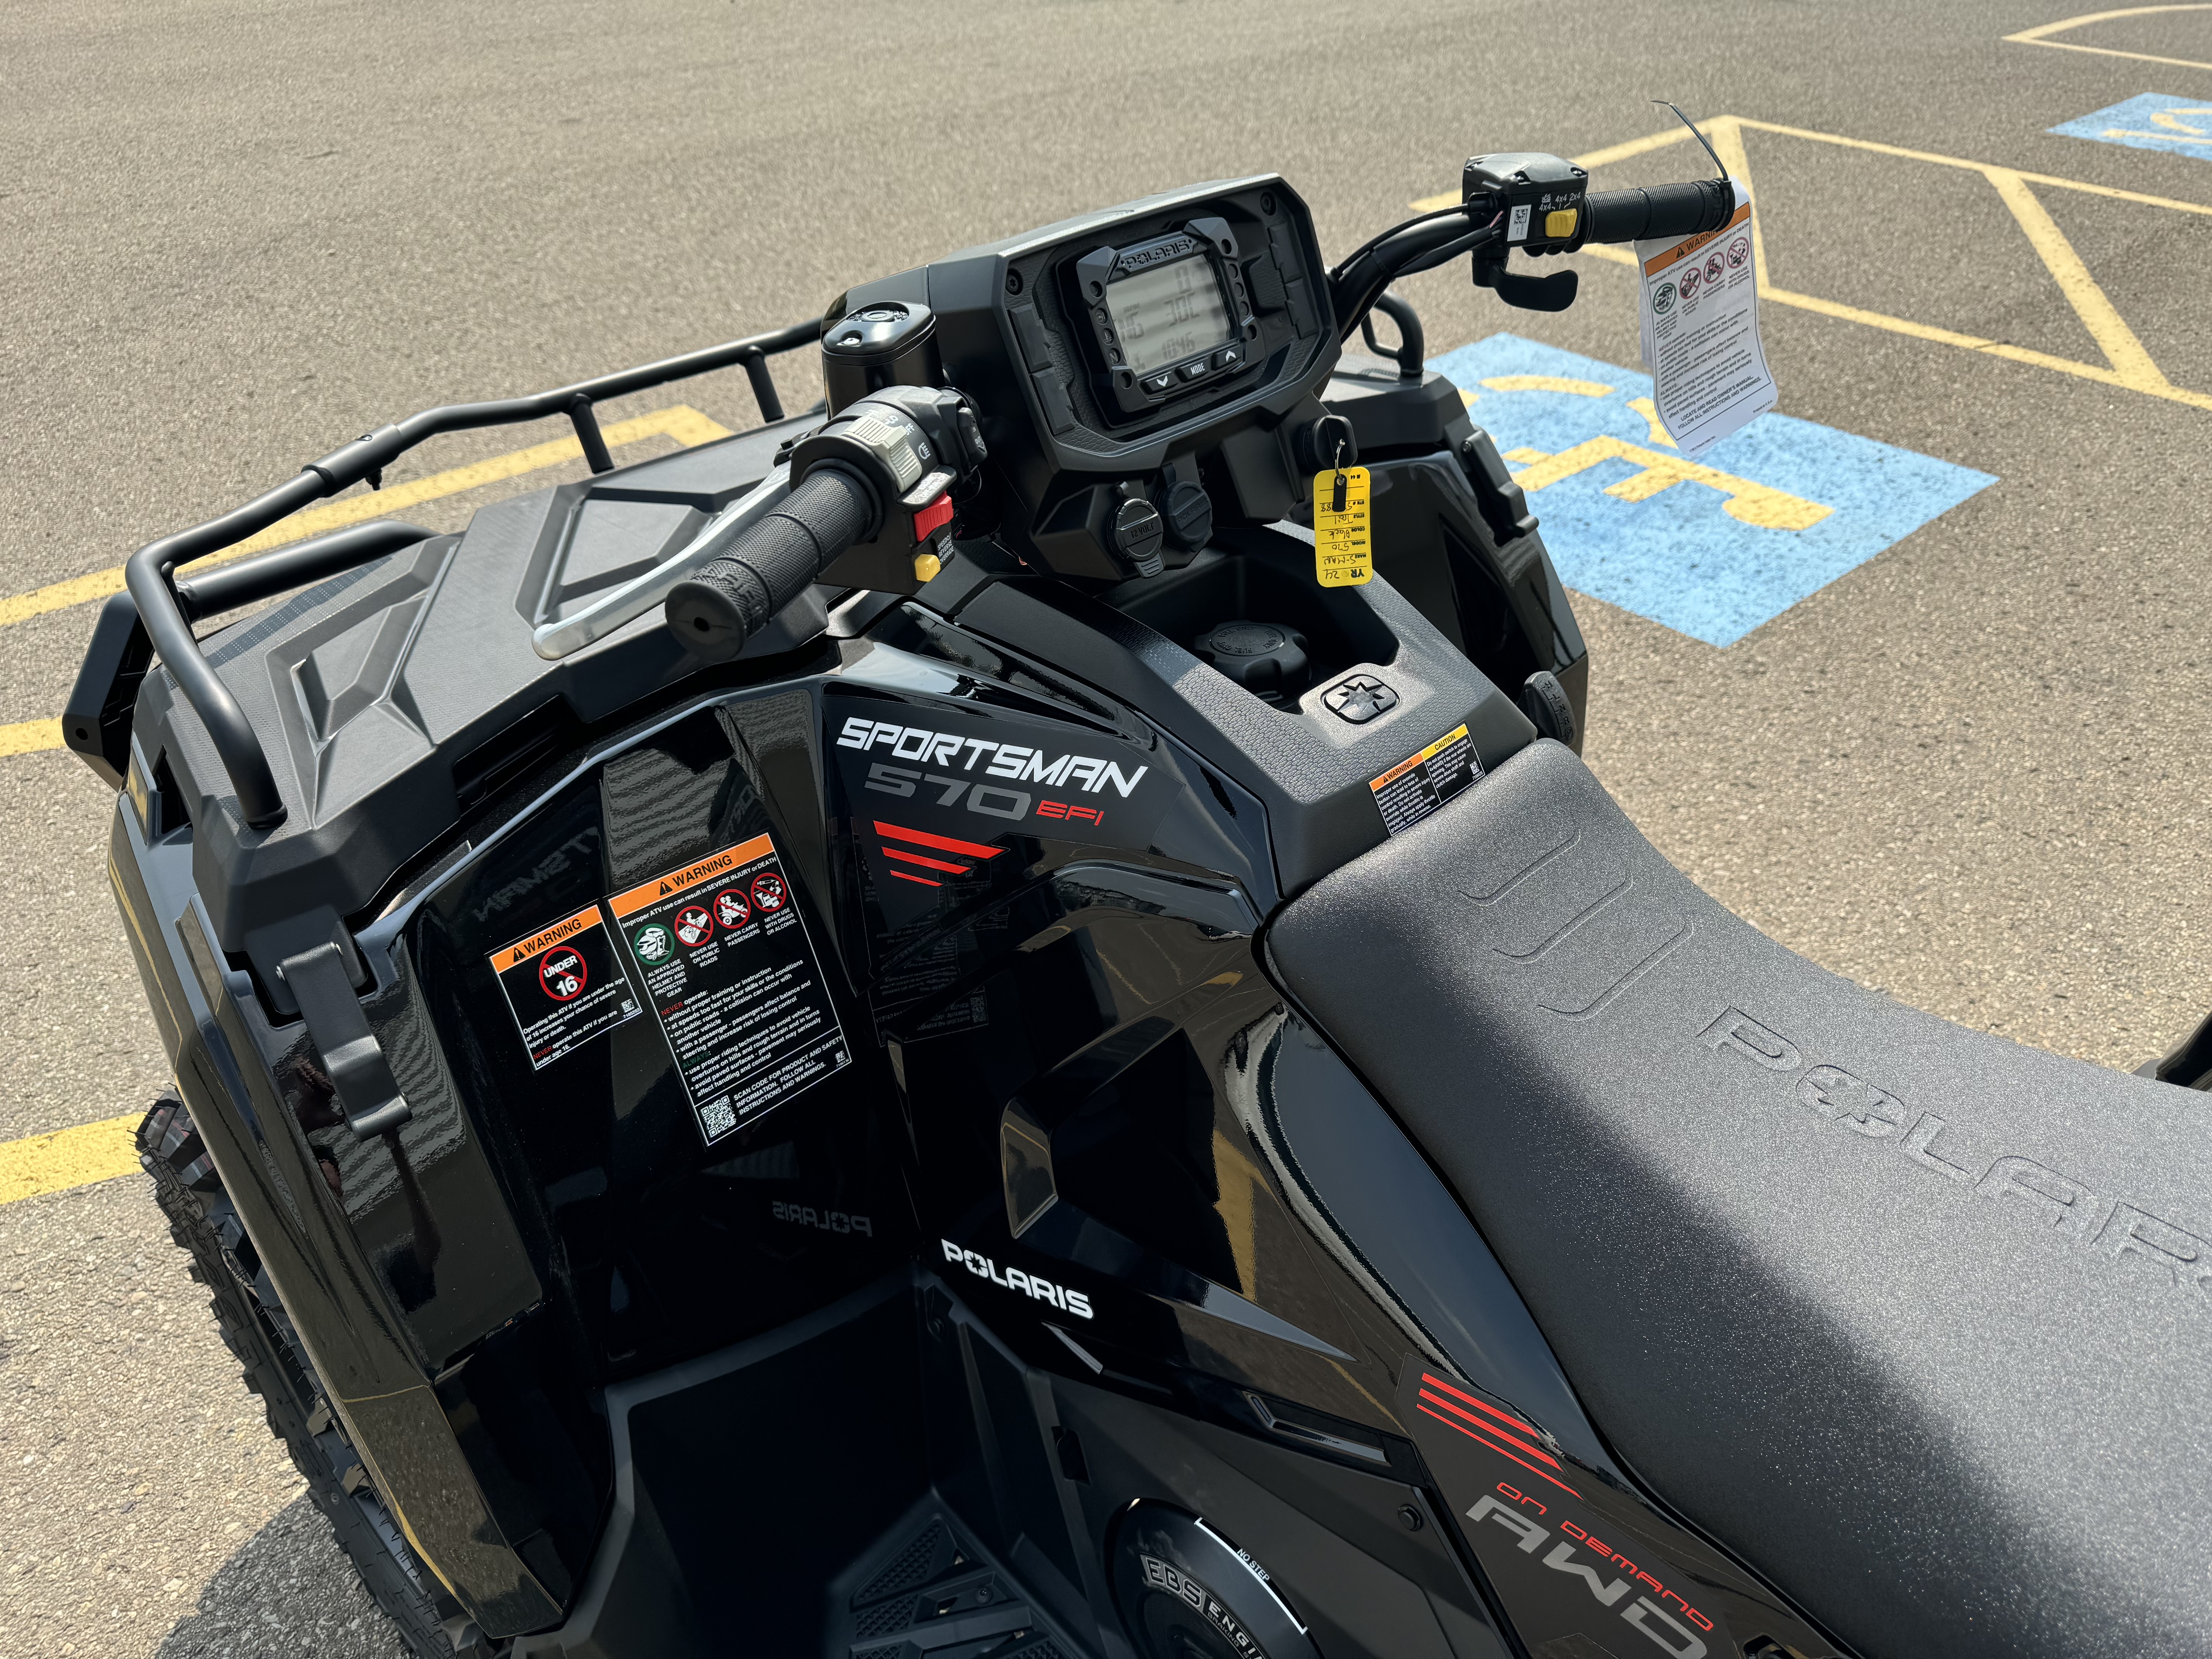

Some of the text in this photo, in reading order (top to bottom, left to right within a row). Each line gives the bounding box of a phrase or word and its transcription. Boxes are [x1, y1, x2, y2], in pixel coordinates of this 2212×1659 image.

[1569, 191, 1581, 201] 2x4
[1686, 229, 1716, 251] WARNI
[1124, 239, 1190, 269] POLARIS
[1190, 362, 1205, 374] MODE
[1130, 522, 1153, 538] 12 VOLT
[1328, 529, 1350, 539] Black
[1332, 543, 1349, 551] 570
[1350, 568, 1365, 578] YR
[1434, 733, 1455, 750] CAUTION
[836, 717, 1149, 798] SPORTSMAN
[1387, 760, 1413, 780] WARNING
[864, 762, 1104, 826] 570 EFI
[672, 855, 732, 886] WARNING
[622, 913, 649, 928] Improper
[650, 906, 661, 916] ATV
[685, 890, 701, 900] result
[706, 876, 731, 891] SEVERE
[730, 867, 750, 880] INJURY
[757, 857, 776, 869] DEATH
[764, 912, 780, 922] NEVER
[765, 912, 794, 929] WITH DRUGS
[775, 918, 797, 931] ALCOHOL
[523, 919, 582, 953] WARNING
[724, 922, 757, 941] NEVER CARRY
[727, 929, 760, 946] PASSENGERS
[689, 941, 718, 958] NEVER USE
[701, 948, 720, 959] PUBLIC
[544, 955, 577, 977] UNDER
[648, 958, 681, 977] ALWAYS USE
[700, 956, 718, 967] ROADS
[652, 971, 685, 990] HELMET AND
[657, 964, 684, 981] APPROVED
[556, 975, 577, 996] 16
[655, 977, 687, 996] PROTECTIVE
[667, 987, 682, 997] GEAR
[523, 1018, 548, 1034] Operating
[558, 1005, 567, 1015] ATV
[572, 999, 582, 1008] you
[591, 987, 605, 997] under
[539, 1018, 563, 1034] increases
[563, 1011, 574, 1021] your
[575, 1002, 593, 1013] chance
[599, 990, 616, 1001] severe
[661, 990, 708, 1015] NEVER operate:
[529, 1037, 543, 1048] injury
[550, 1025, 566, 1036] death.
[533, 1046, 551, 1059] NEVER
[552, 1035, 572, 1048] operate
[583, 1022, 592, 1031] ATV
[598, 1015, 608, 1024] you
[733, 1035, 842, 1100] SCAN CODE FOR PRODUCT AND SAFETY
[736, 1060, 816, 1108] INFORMATION. FOLLOW ALL
[739, 1087, 781, 1115] INSTRUCTIONS
[783, 1080, 794, 1090] AND
[795, 1062, 826, 1082] WARNINGS.
[941, 1238, 1094, 1320] POLARIS
[1237, 1548, 1270, 1582] NO STEP
[1496, 1482, 1714, 1632] ON DEMAND
[1465, 1494, 1707, 1659] AWD
[1145, 1556, 1262, 1659] EBS ENGI
[1208, 1612, 1240, 1647] BRAKING
